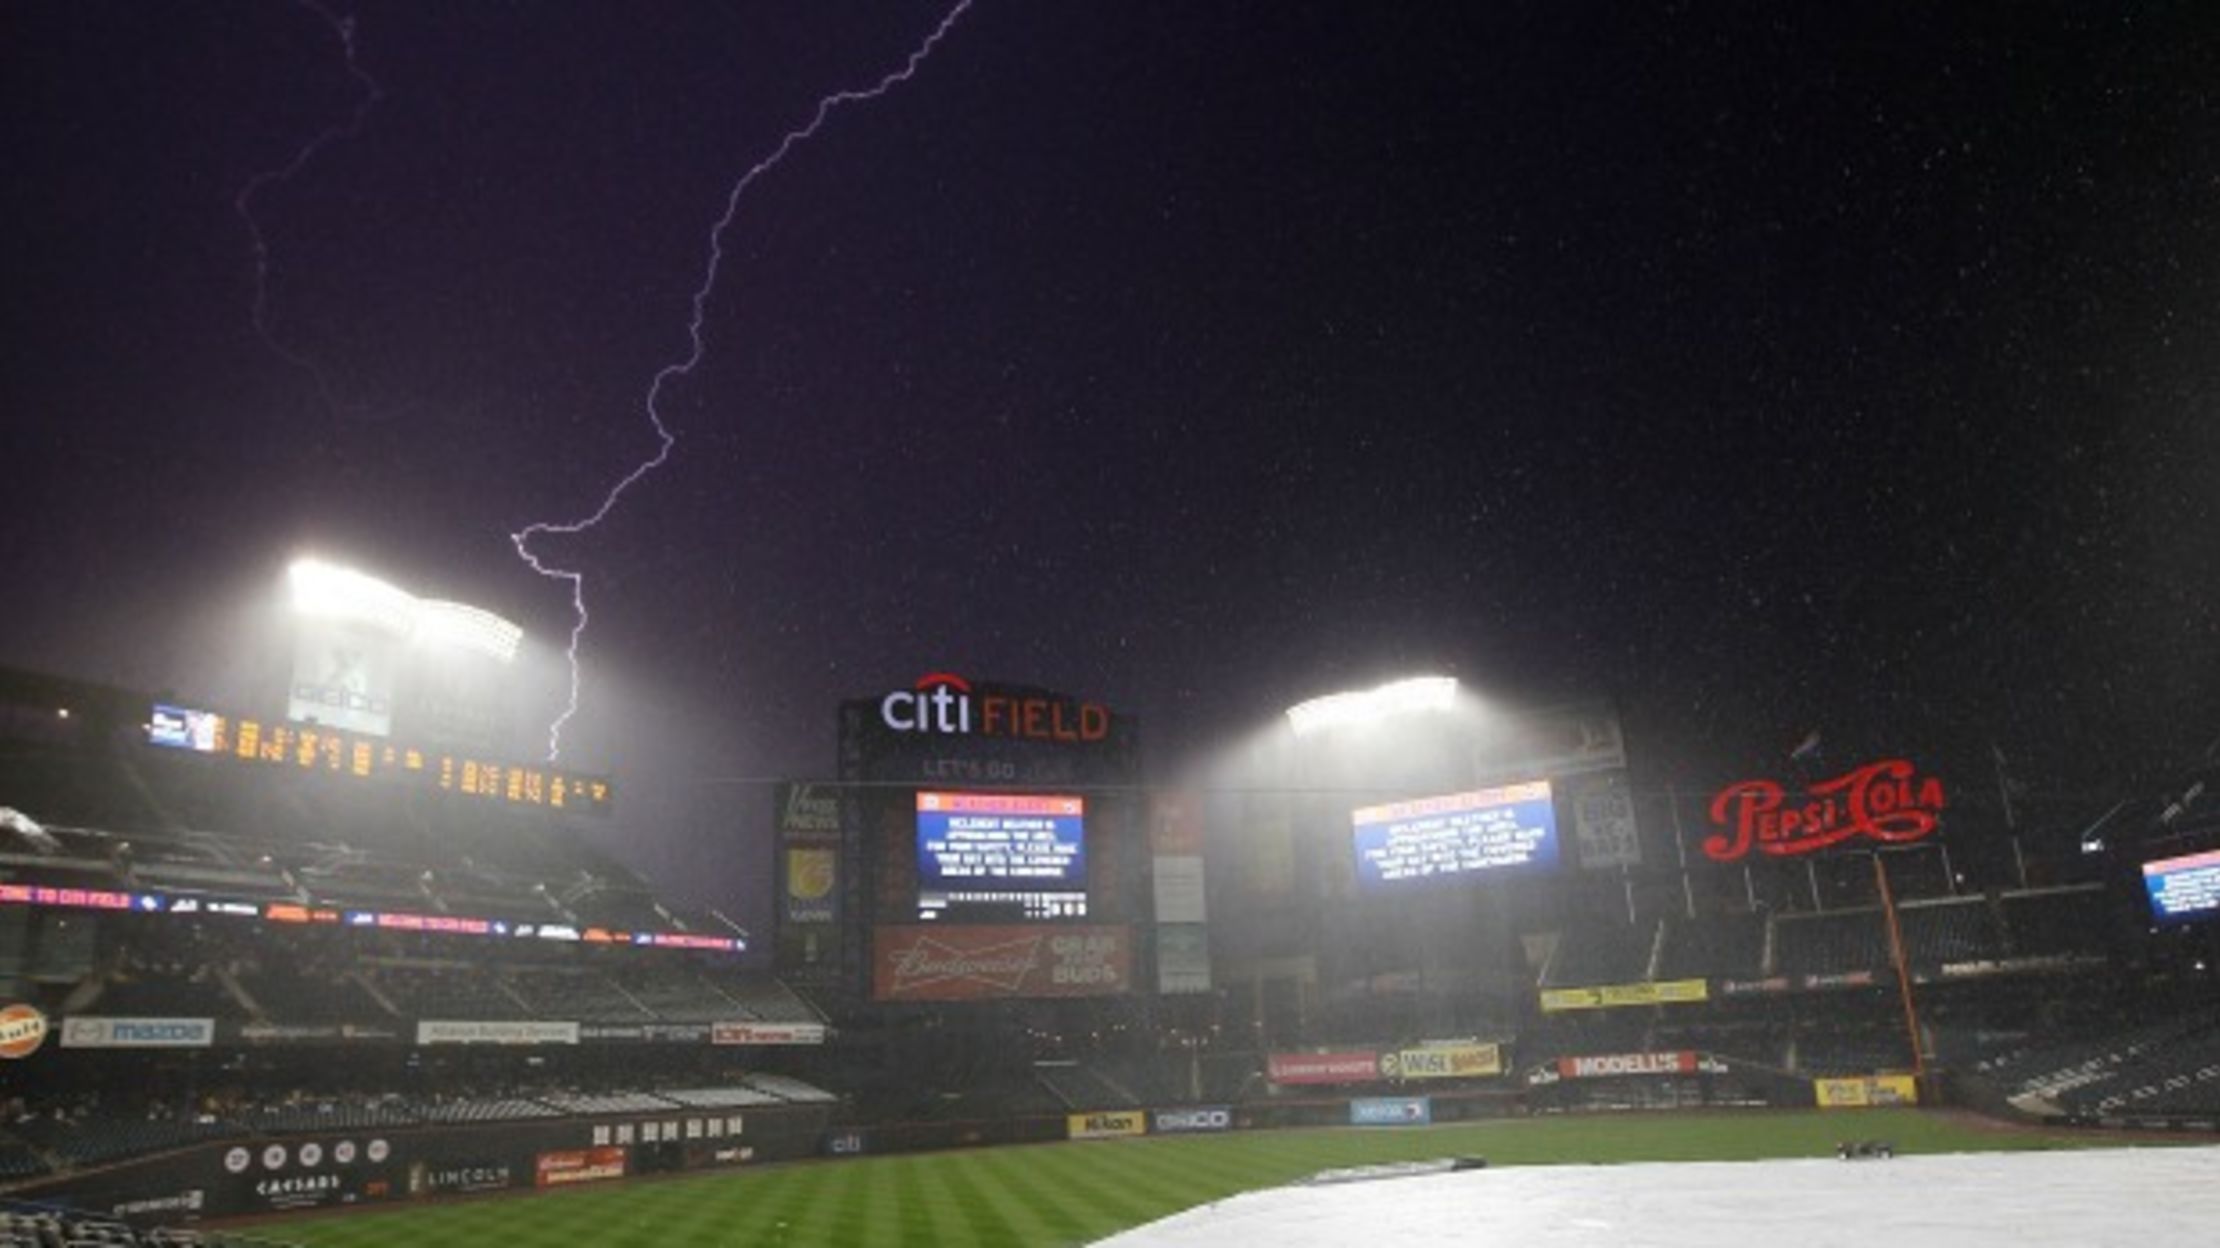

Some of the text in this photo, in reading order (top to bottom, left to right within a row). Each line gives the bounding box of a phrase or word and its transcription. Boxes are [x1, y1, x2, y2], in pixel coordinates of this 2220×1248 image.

[882, 680, 1110, 740] citi FIELD
[1574, 1052, 1679, 1077] MODELL'S
[428, 1167, 510, 1186] LINCOLN
